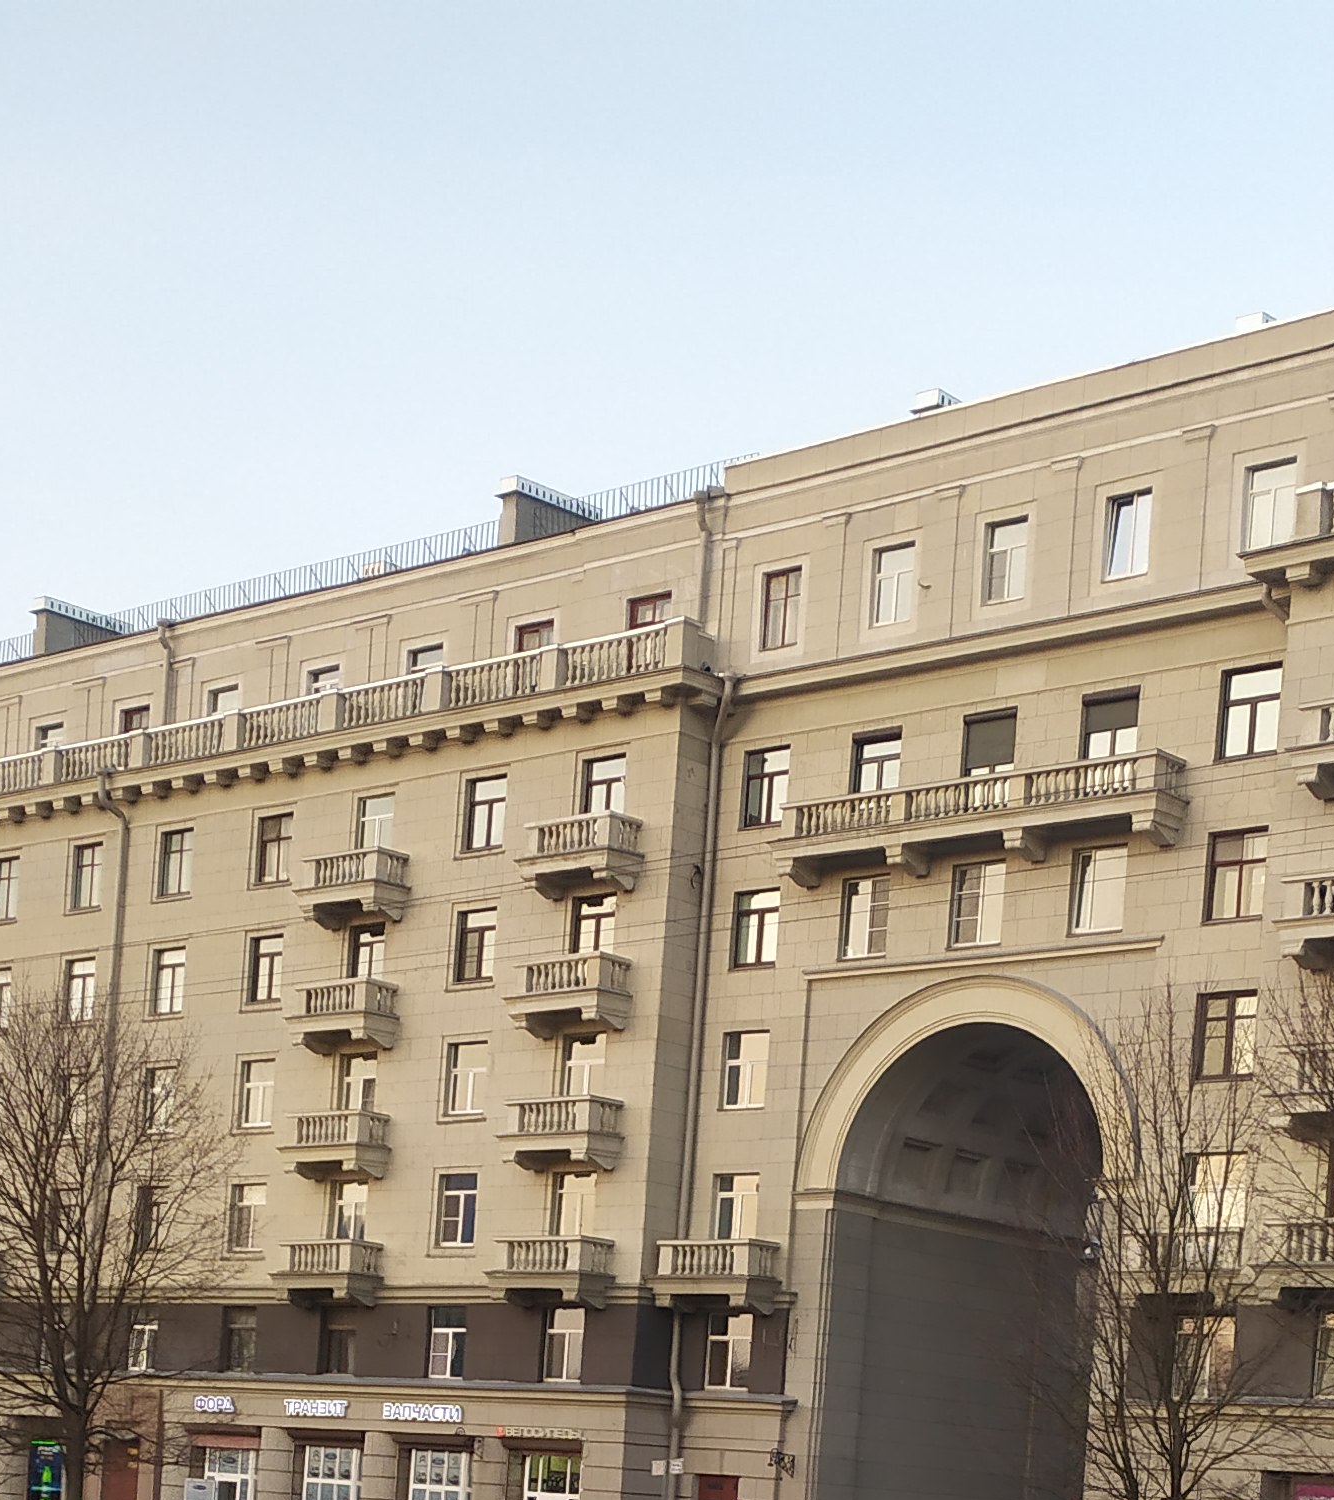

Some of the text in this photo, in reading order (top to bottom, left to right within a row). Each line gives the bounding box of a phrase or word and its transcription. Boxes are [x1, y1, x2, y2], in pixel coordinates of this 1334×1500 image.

[193, 1395, 463, 1422] ФОРД ТРАНЗИТ ЗАПЧАСТИ
